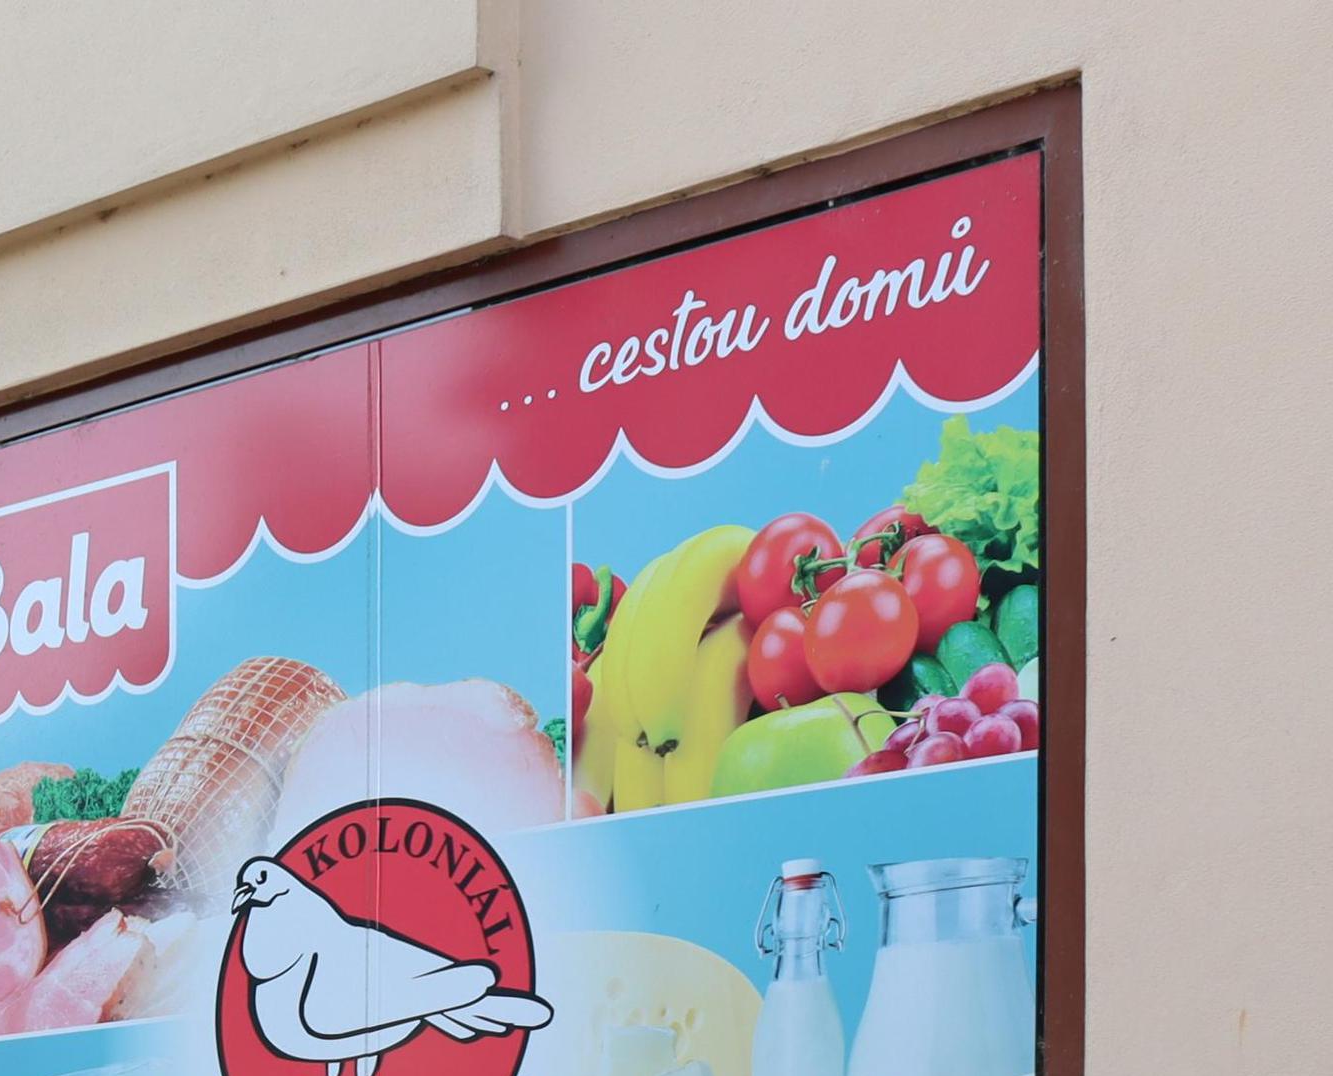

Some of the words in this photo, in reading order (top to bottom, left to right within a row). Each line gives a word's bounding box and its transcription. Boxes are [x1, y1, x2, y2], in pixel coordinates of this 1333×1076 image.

[579, 290, 770, 393] cestou
[783, 216, 991, 341] domů
[301, 816, 515, 956] KOLONIÁL
